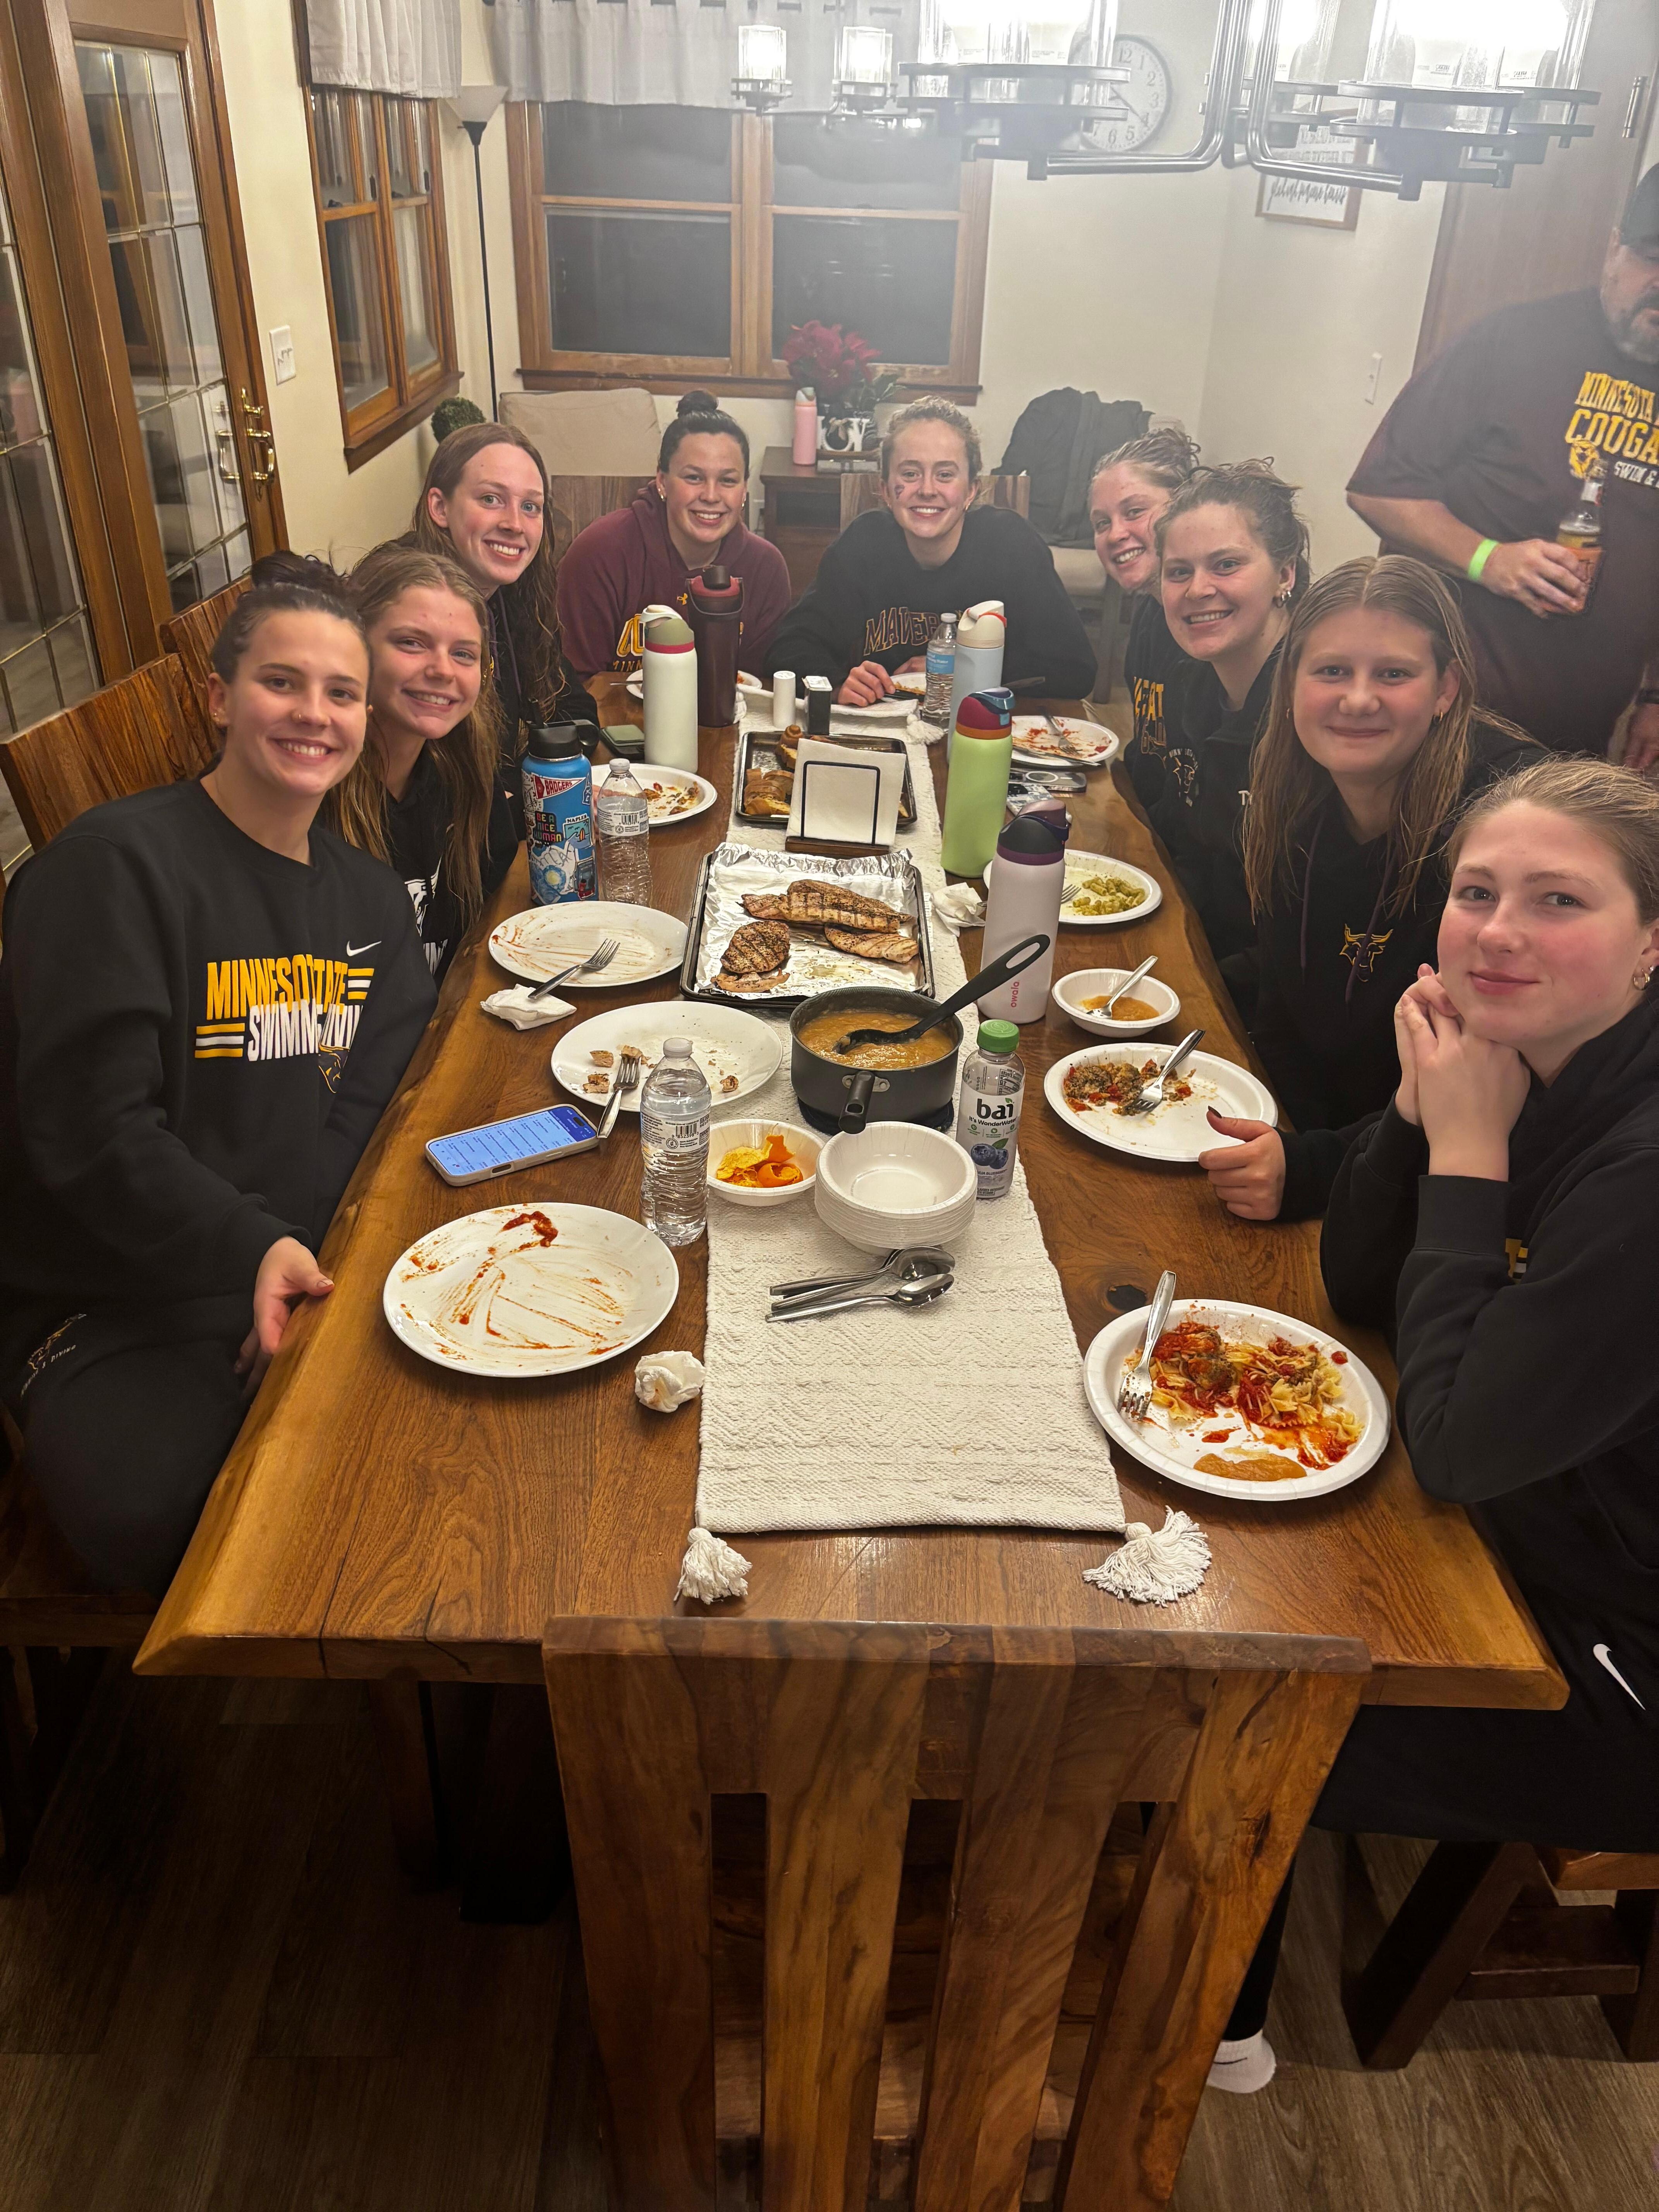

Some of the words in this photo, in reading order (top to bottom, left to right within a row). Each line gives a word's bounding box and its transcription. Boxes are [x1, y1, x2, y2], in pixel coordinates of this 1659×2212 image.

[1118, 48, 1132, 63] 12
[1139, 55, 1144, 70] 1
[1147, 71, 1156, 86] 2
[1150, 92, 1159, 108] 3
[1108, 128, 1117, 144] 6
[1125, 125, 1135, 141] 5
[1565, 409, 1659, 465] COUGA
[863, 606, 940, 656] MAVER
[544, 780, 572, 795] BADGERS
[537, 813, 546, 822] BE
[567, 814, 587, 823] NAPLES
[1011, 981, 1020, 1008] owala
[976, 1097, 1014, 1120] bai
